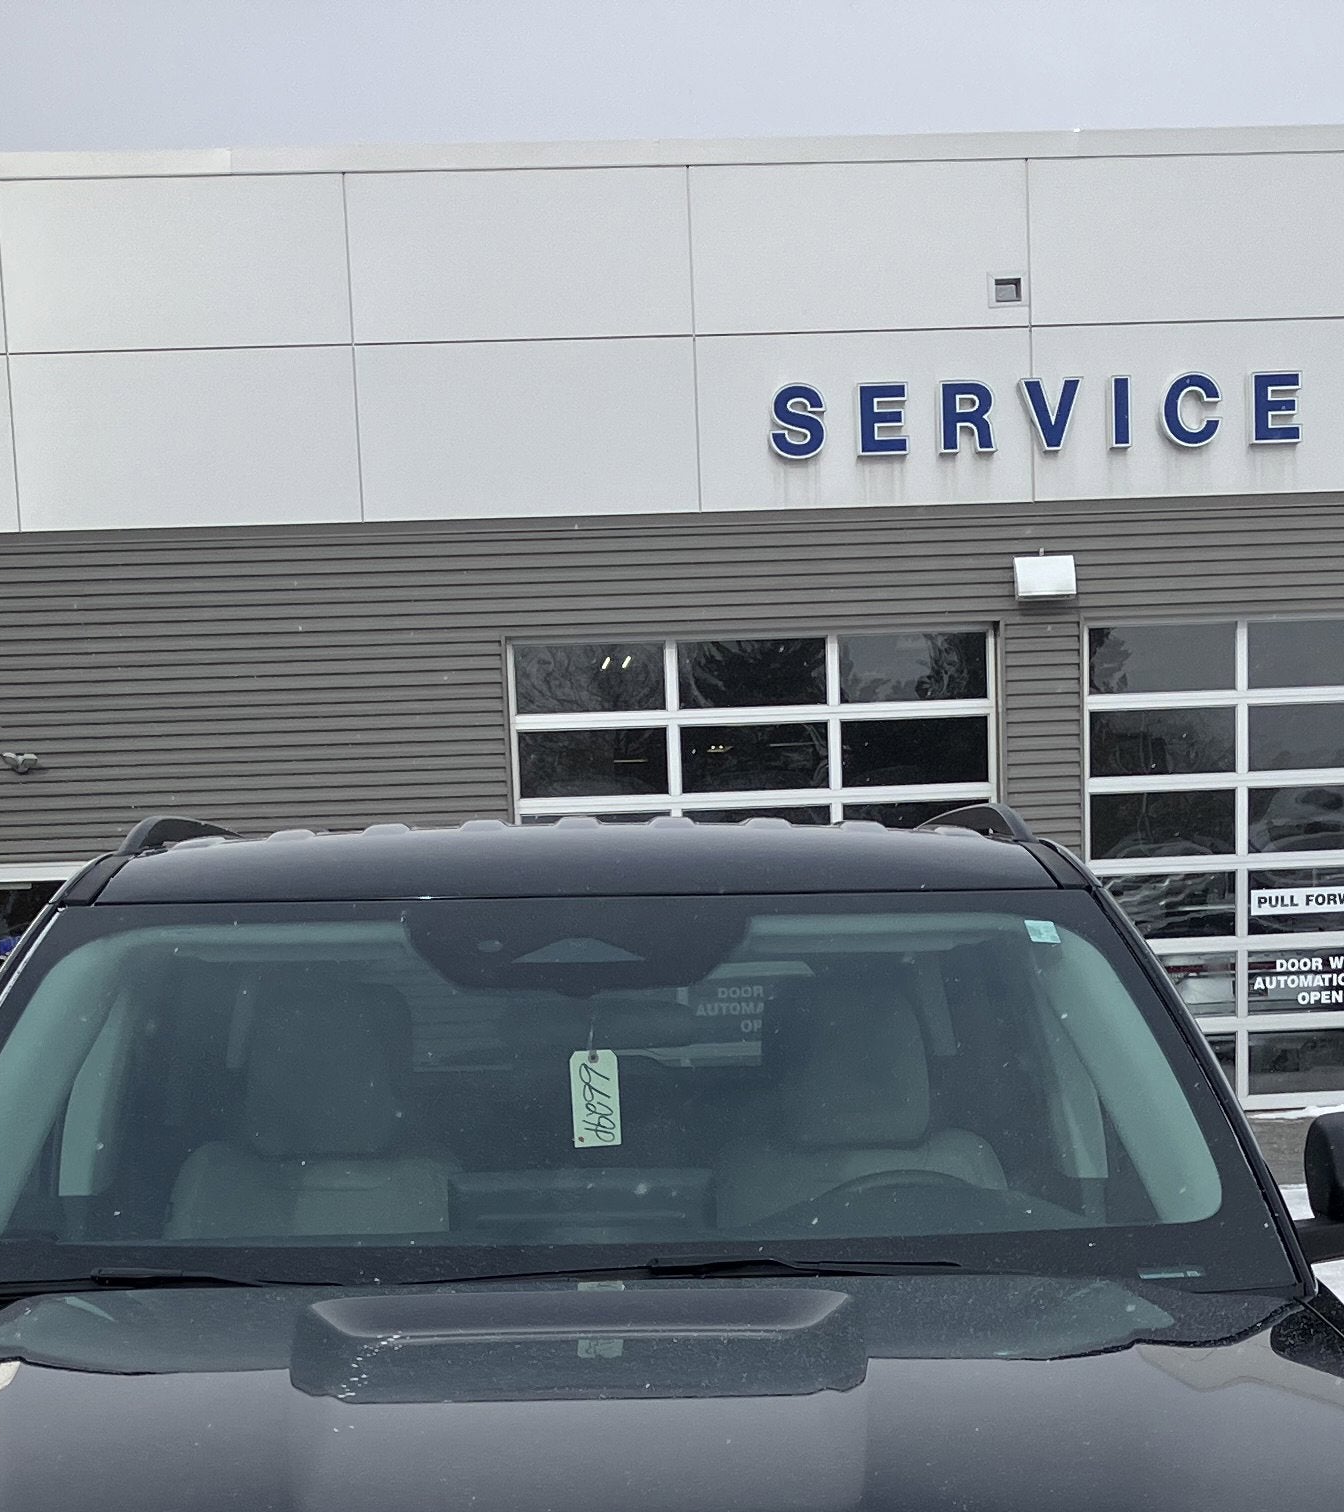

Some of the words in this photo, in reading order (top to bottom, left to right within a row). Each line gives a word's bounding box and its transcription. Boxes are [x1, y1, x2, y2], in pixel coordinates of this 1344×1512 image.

[768, 370, 1303, 460] SERVICE
[1257, 894, 1299, 909] PULL
[1275, 957, 1323, 972] DOOR
[717, 985, 764, 999] DOOR
[1297, 989, 1344, 1005] OPEN
